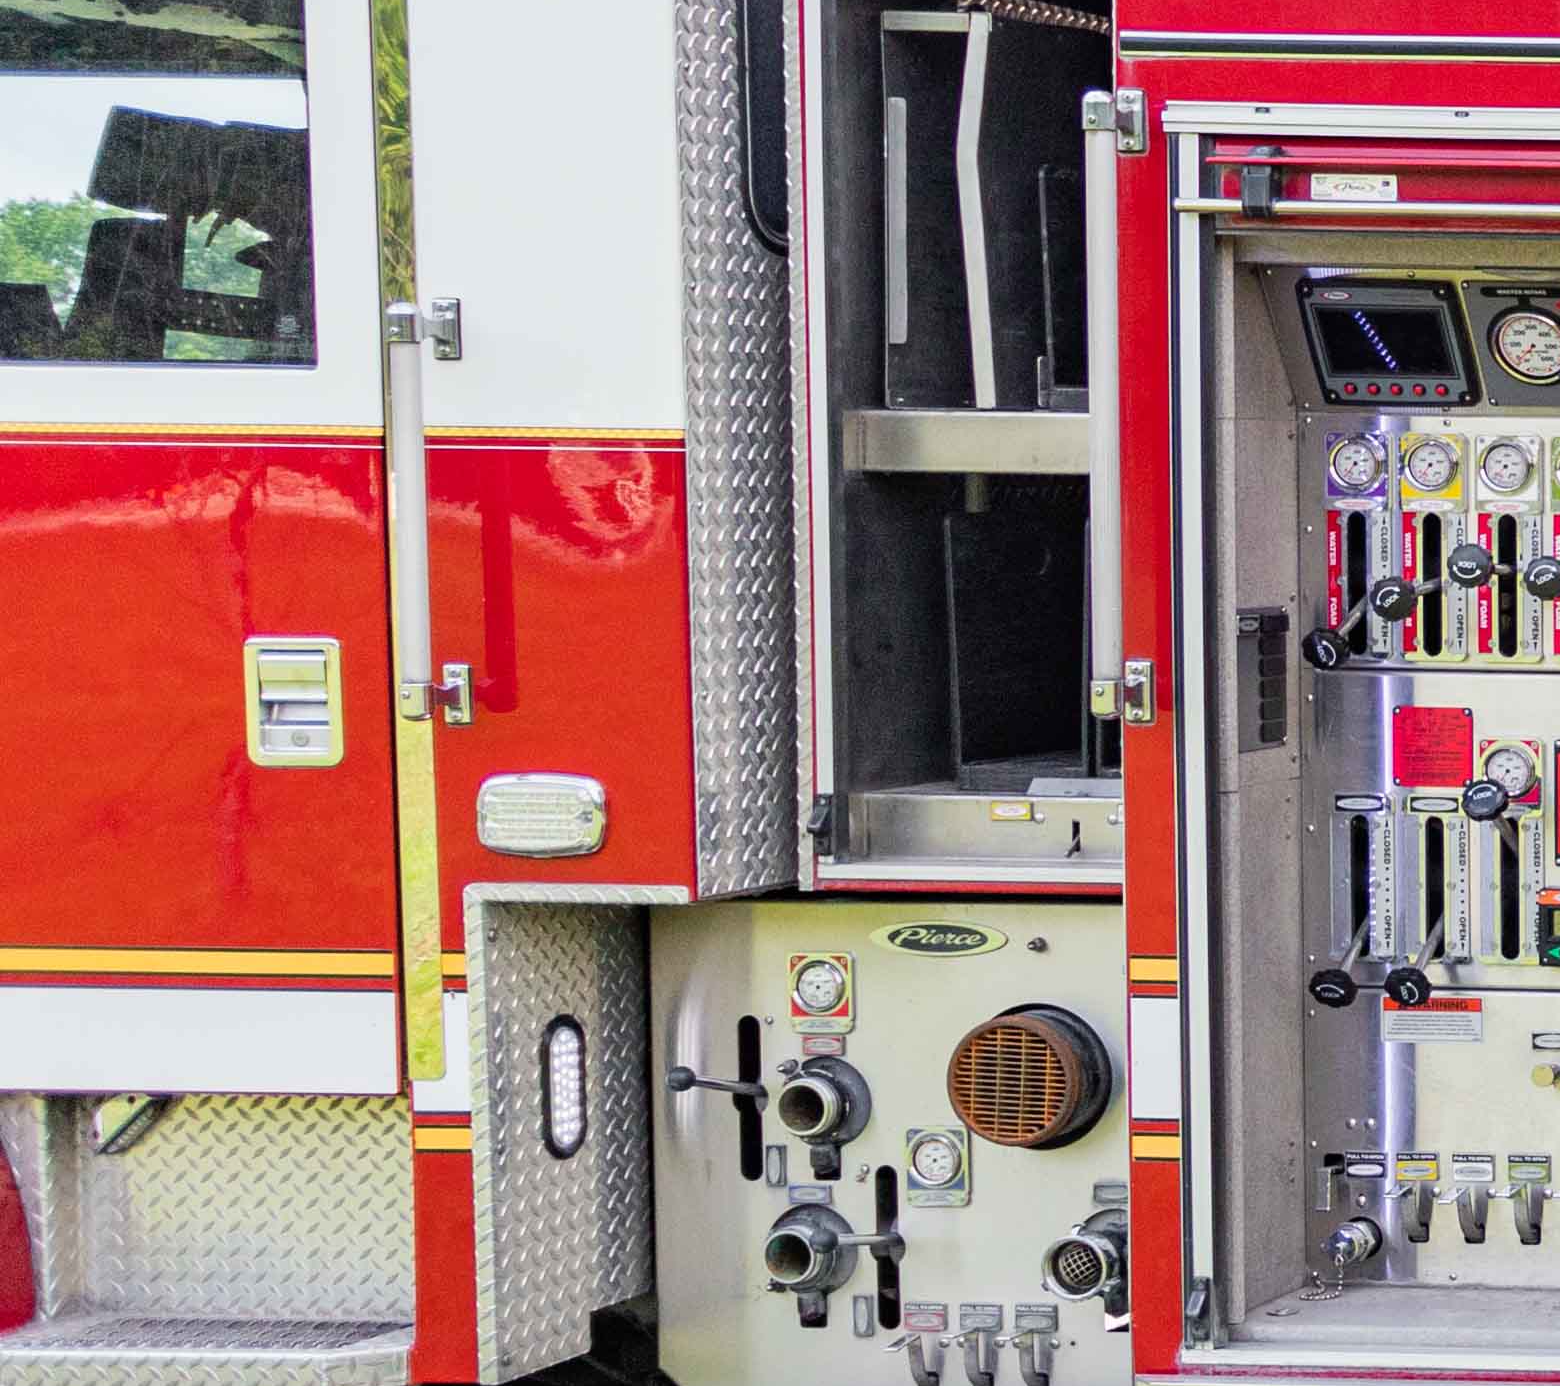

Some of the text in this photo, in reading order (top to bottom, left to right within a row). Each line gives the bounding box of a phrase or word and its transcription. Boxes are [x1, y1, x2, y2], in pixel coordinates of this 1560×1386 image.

[1329, 531, 1337, 566] WATER
[1458, 560, 1477, 570] LOCK
[1536, 573, 1555, 585] LOCK
[1382, 593, 1400, 608] LOCK
[1329, 597, 1337, 627] FOAM
[1480, 599, 1488, 629] FOAM
[1457, 613, 1465, 639] OPEN
[1316, 643, 1328, 663] LOCK
[1472, 792, 1492, 800] LOCK
[893, 926, 986, 947] Pierce
